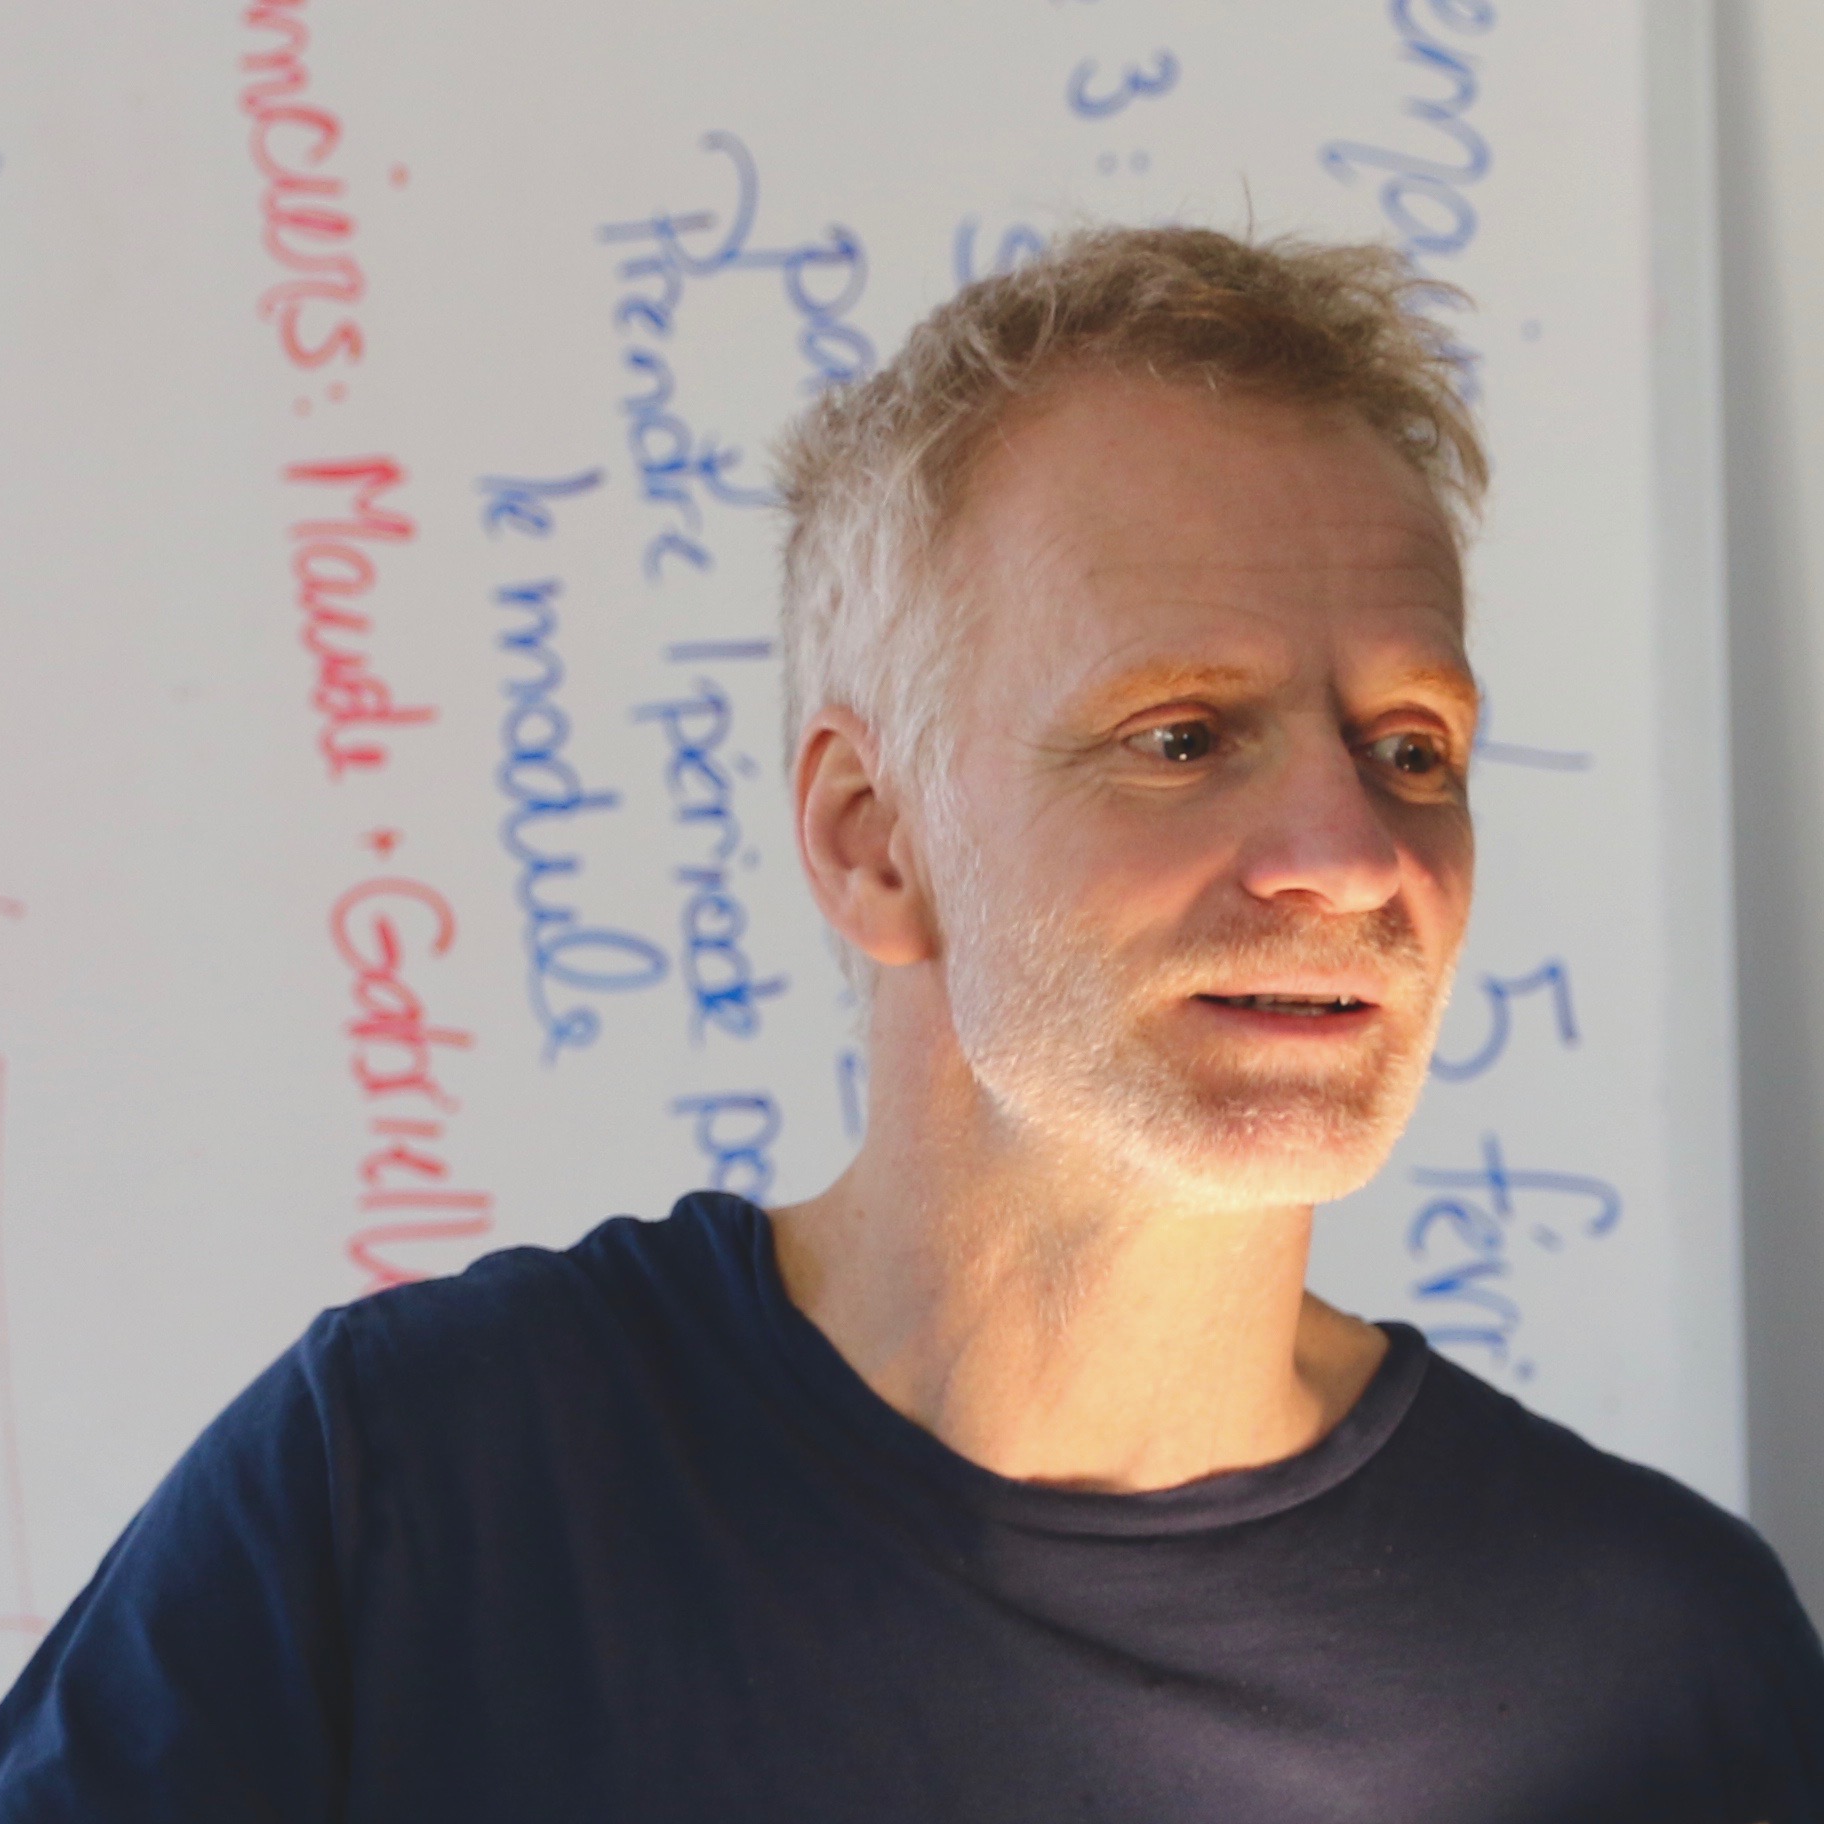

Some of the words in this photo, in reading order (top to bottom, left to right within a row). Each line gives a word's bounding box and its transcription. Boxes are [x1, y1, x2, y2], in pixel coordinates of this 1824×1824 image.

[478, 465, 606, 543] le
[595, 130, 758, 585] Prendre
[279, 449, 442, 785] Maude
[491, 573, 674, 1067] module
[633, 677, 791, 1049] période
[326, 874, 497, 1297] Gabriell
[1430, 955, 1582, 1086] 5
